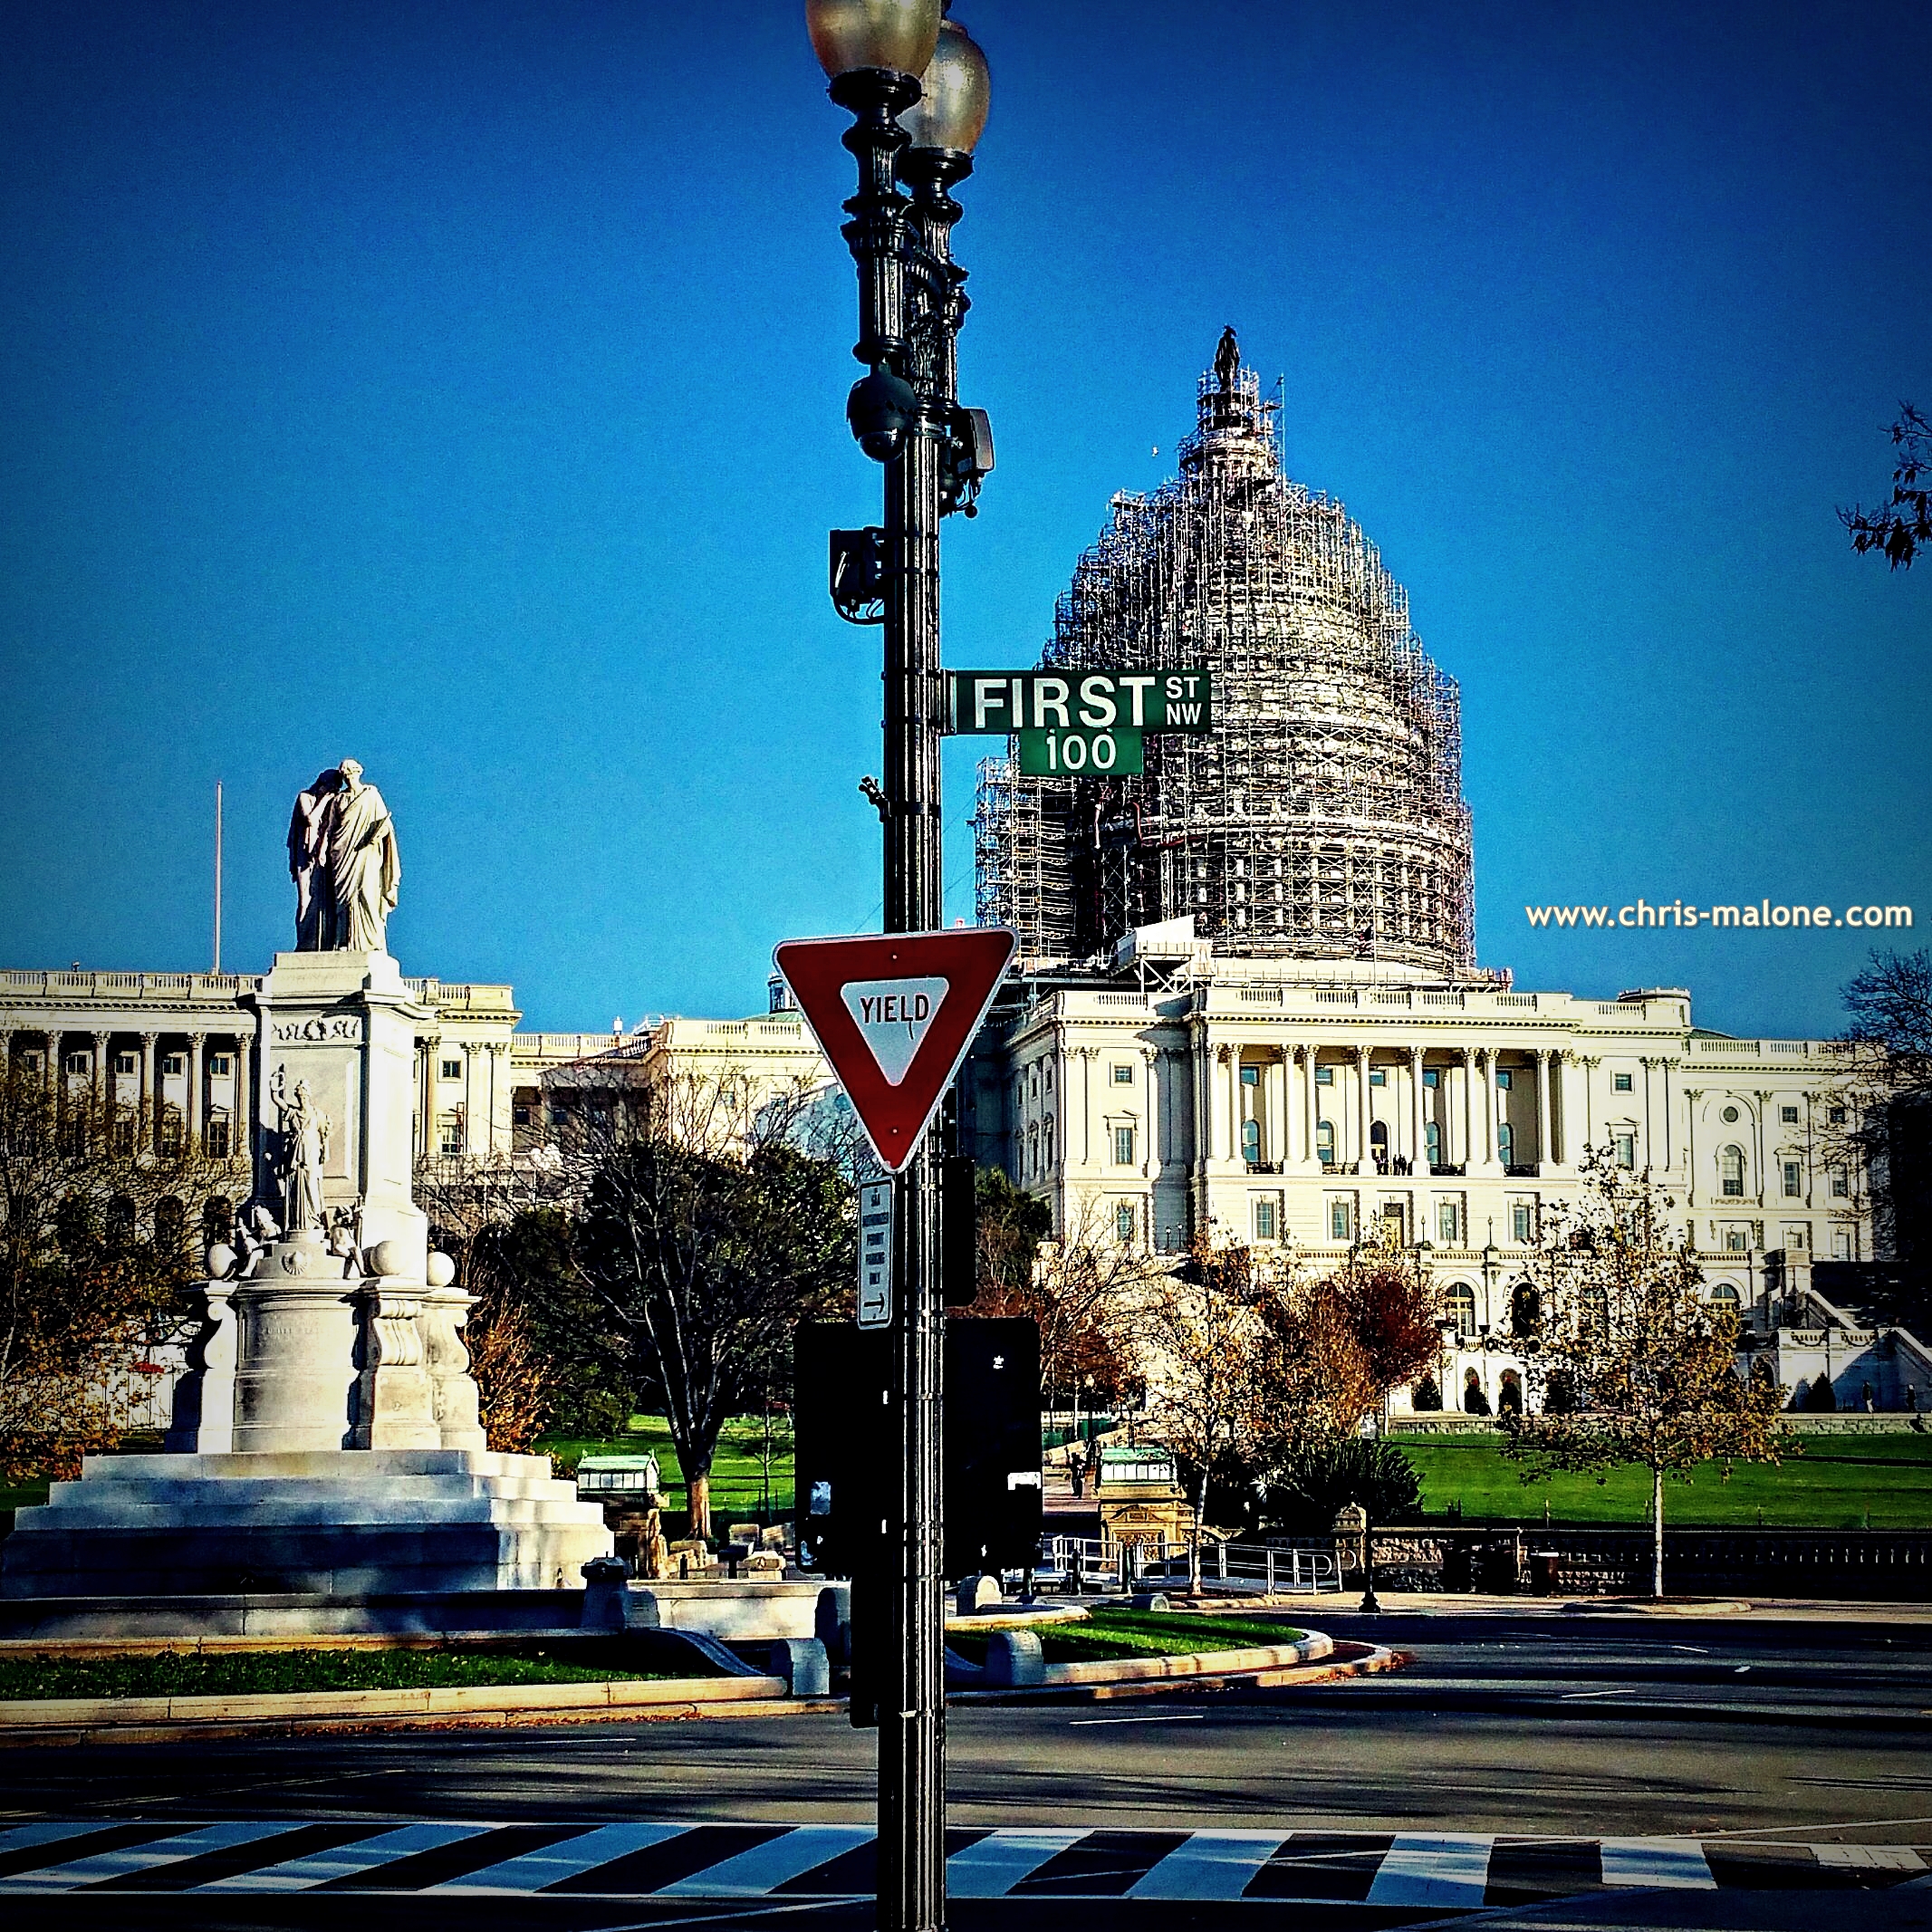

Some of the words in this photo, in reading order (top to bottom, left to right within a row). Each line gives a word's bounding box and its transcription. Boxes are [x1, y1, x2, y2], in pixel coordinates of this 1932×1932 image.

[975, 676, 1156, 728] FIRST
[1166, 676, 1199, 699] ST
[1166, 703, 1201, 726] NW
[1046, 735, 1116, 770] 100
[860, 995, 929, 1024] YIELD
